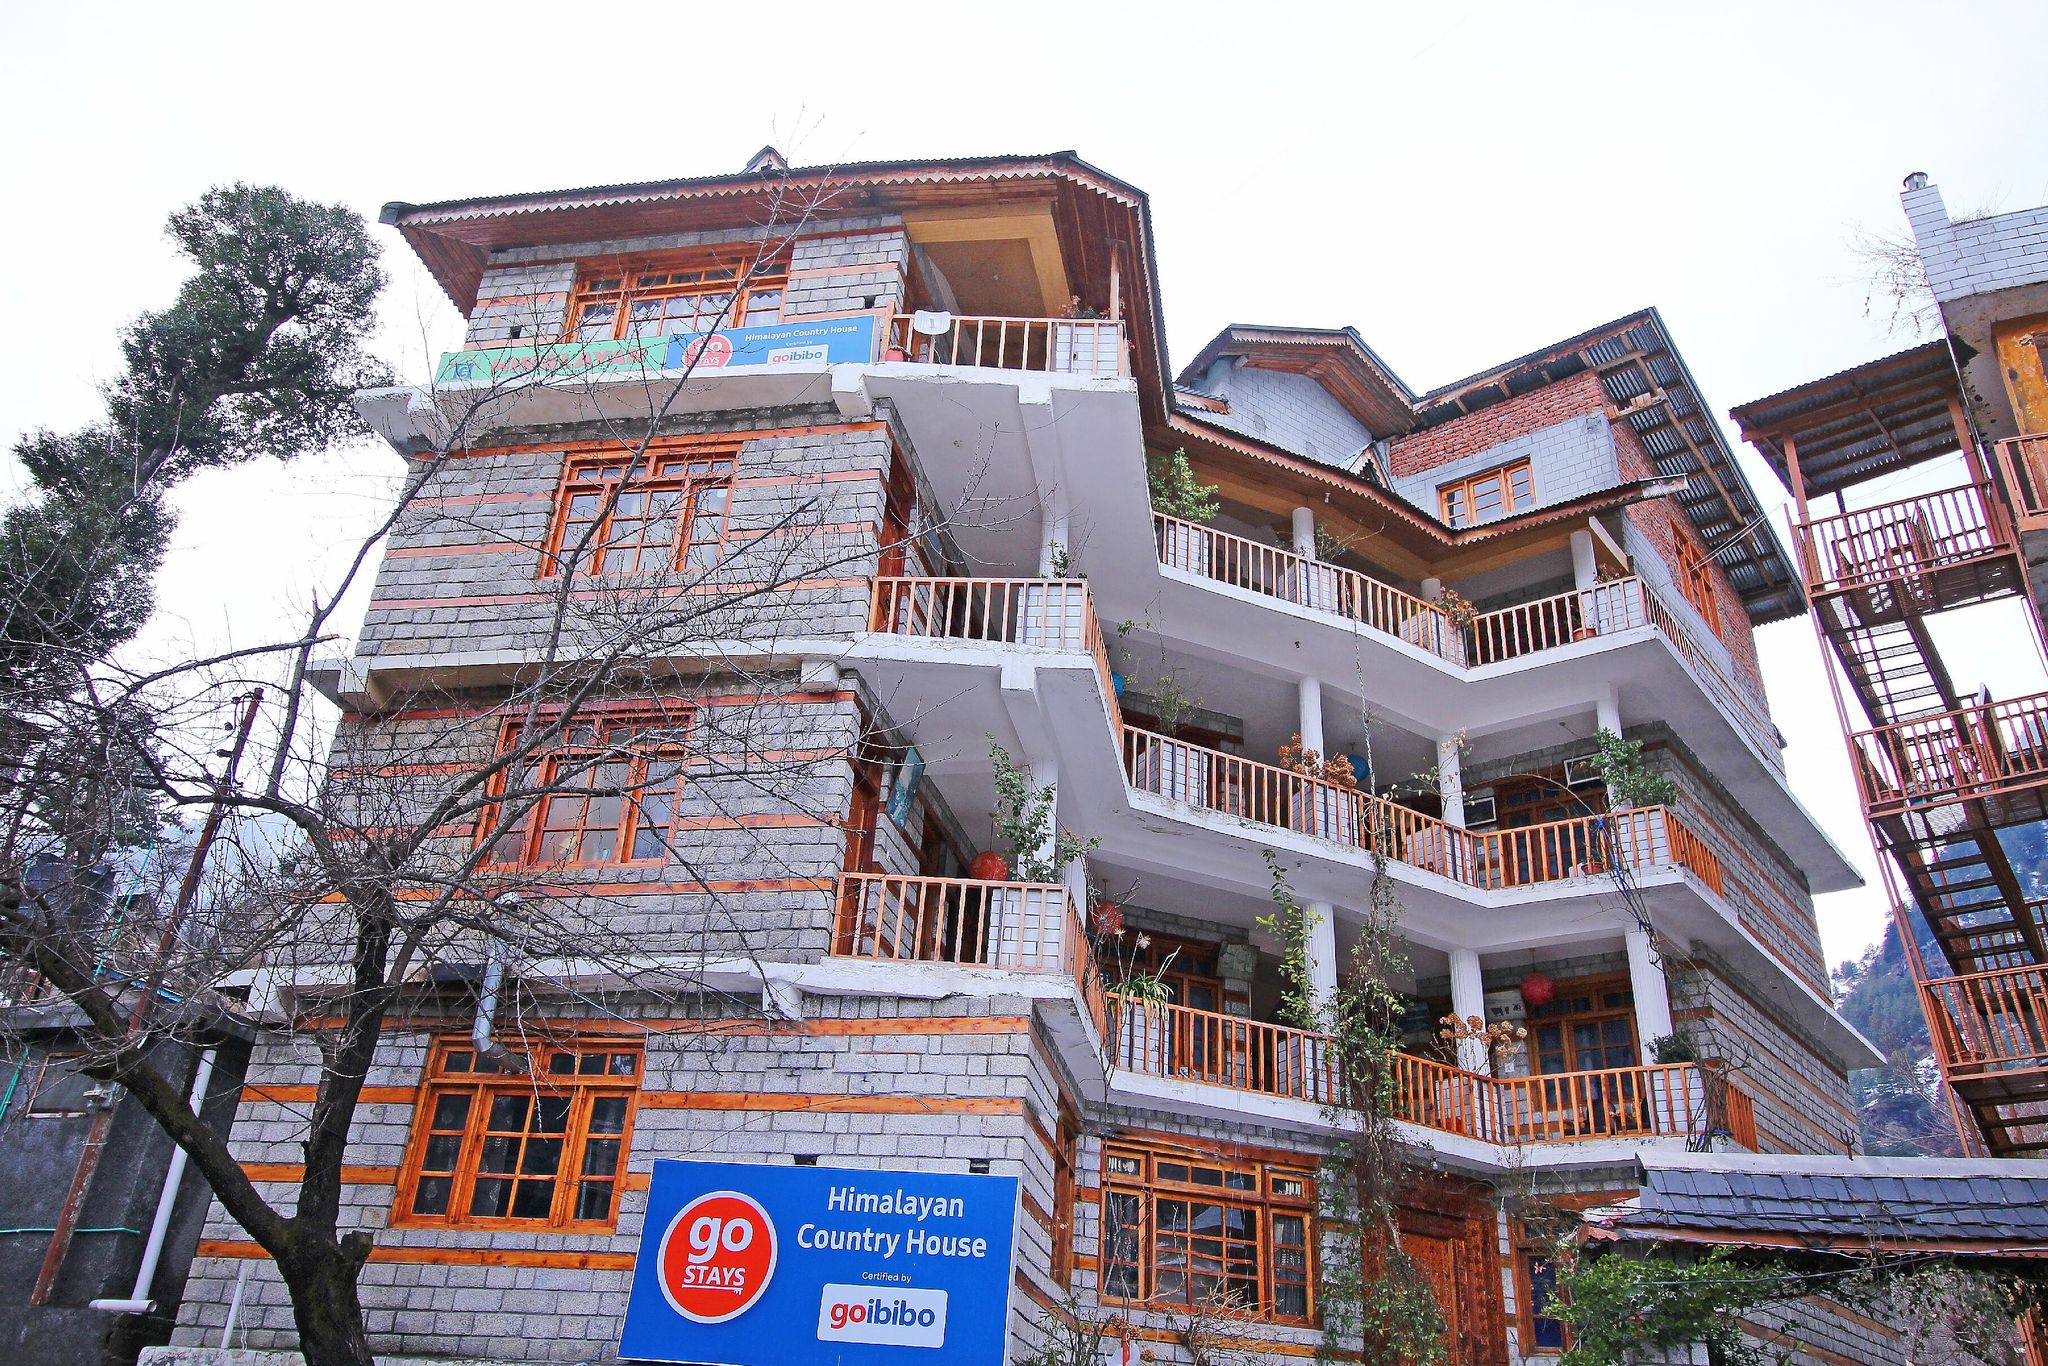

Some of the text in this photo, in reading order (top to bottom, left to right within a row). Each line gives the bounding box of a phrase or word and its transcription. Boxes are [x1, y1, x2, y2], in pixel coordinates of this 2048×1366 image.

[745, 325, 858, 342] Himalayan Country House
[772, 350, 823, 363] goibibo
[827, 1186, 964, 1222] Himalayan
[688, 1216, 754, 1264] go
[797, 1223, 987, 1259] Country House
[683, 1265, 746, 1286] STAYS
[862, 1271, 912, 1284] Certified by
[830, 1298, 936, 1329] goibibo
